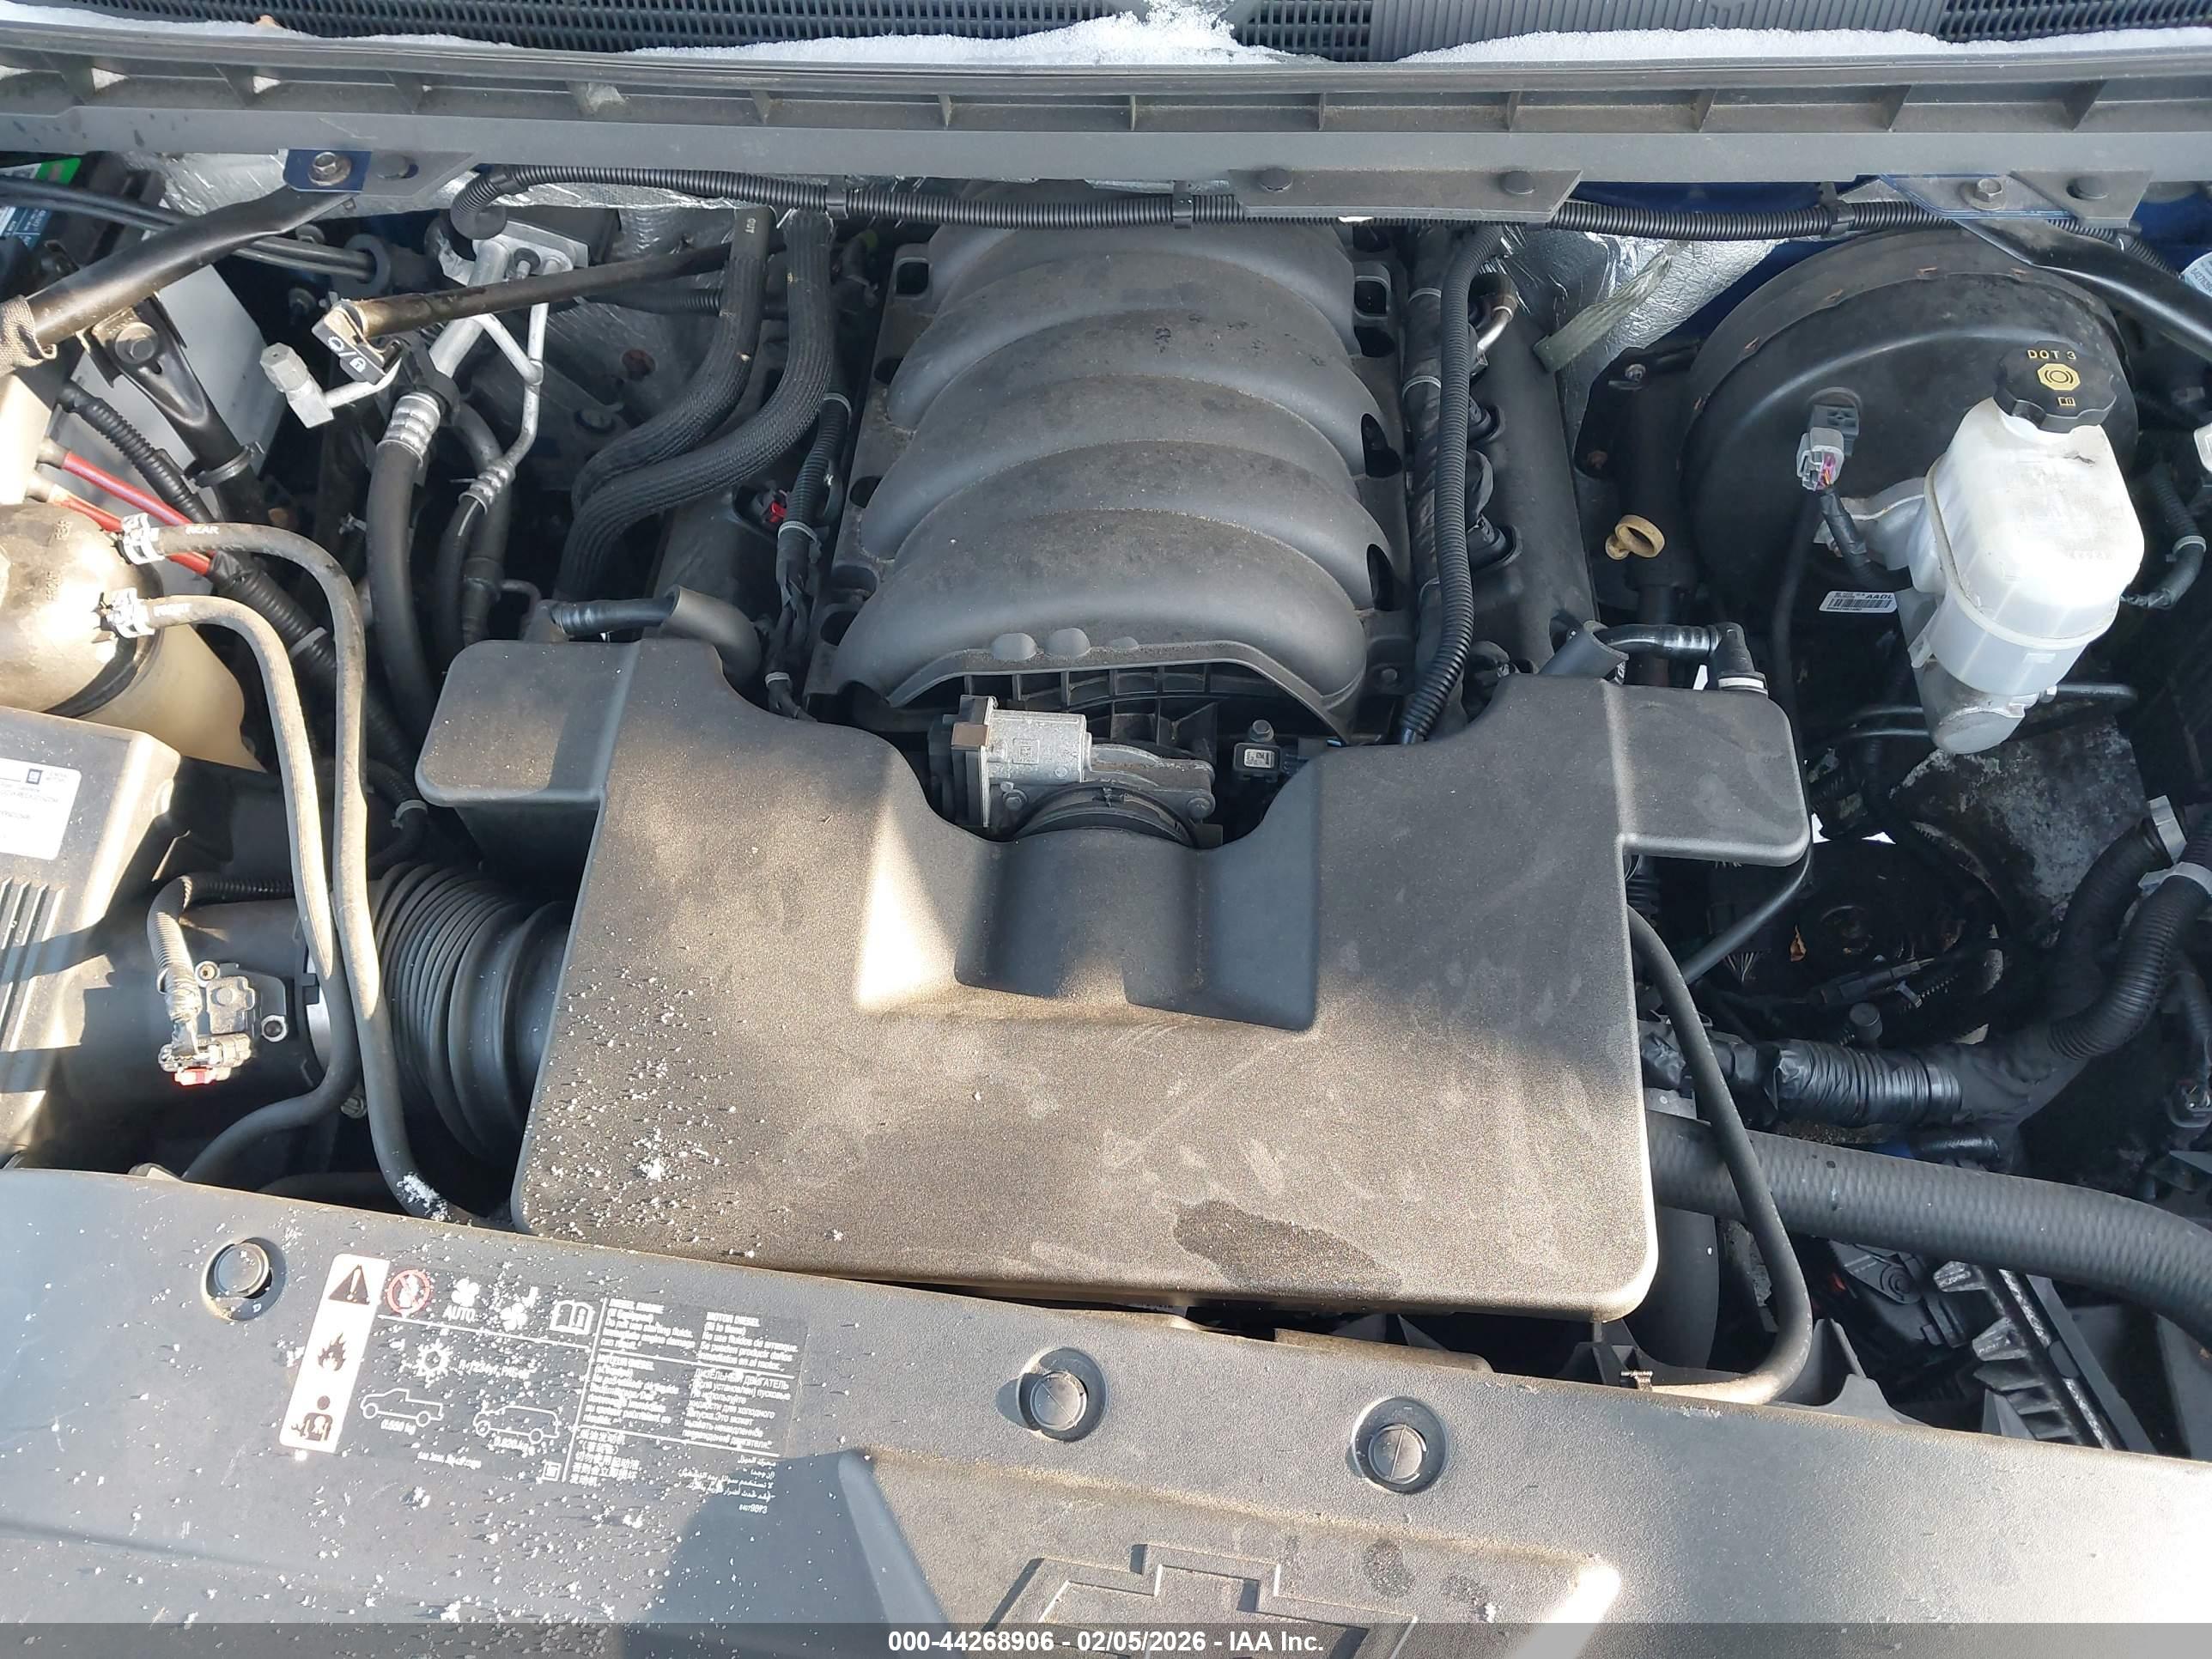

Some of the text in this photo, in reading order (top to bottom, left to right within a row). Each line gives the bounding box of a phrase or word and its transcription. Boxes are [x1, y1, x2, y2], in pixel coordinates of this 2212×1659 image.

[745, 218, 756, 234] OUT
[2027, 349, 2076, 360] DOT 3
[185, 526, 219, 535] REAR
[442, 1304, 476, 1323] AUTO
[706, 1312, 761, 1328] MOTOR DIESEL
[629, 1322, 643, 1331] use
[643, 1323, 671, 1336] starting
[715, 1322, 724, 1332] lo
[725, 1324, 746, 1336] tiene)
[702, 1331, 799, 1353] No use fluidos de arranque.
[700, 1340, 793, 1363] Se pueden producir daños
[738, 1358, 749, 1366] en
[743, 1375, 789, 1389] ДВИГАТЕЛЬ
